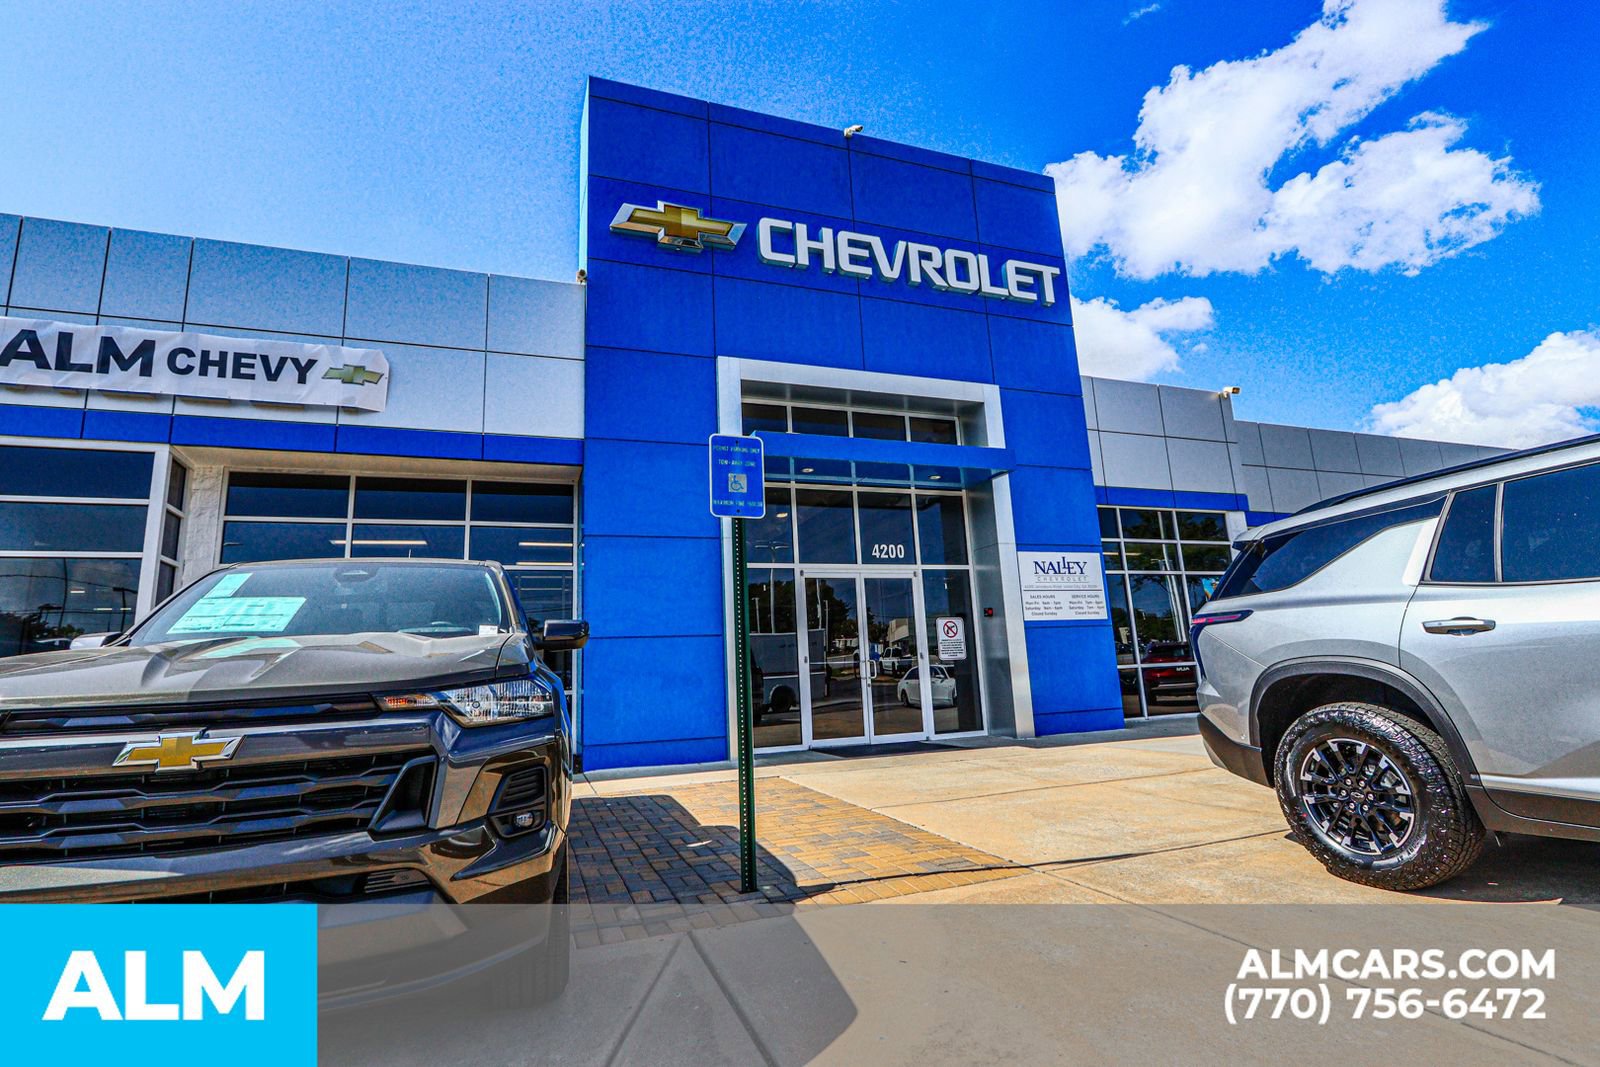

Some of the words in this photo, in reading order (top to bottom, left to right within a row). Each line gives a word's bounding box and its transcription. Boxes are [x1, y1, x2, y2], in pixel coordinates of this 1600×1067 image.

[757, 216, 1061, 306] CHEVROLET
[0, 328, 156, 378] ALM
[166, 347, 318, 384] CHEVY
[872, 544, 905, 558] 4200
[1033, 556, 1088, 575] NALLEY
